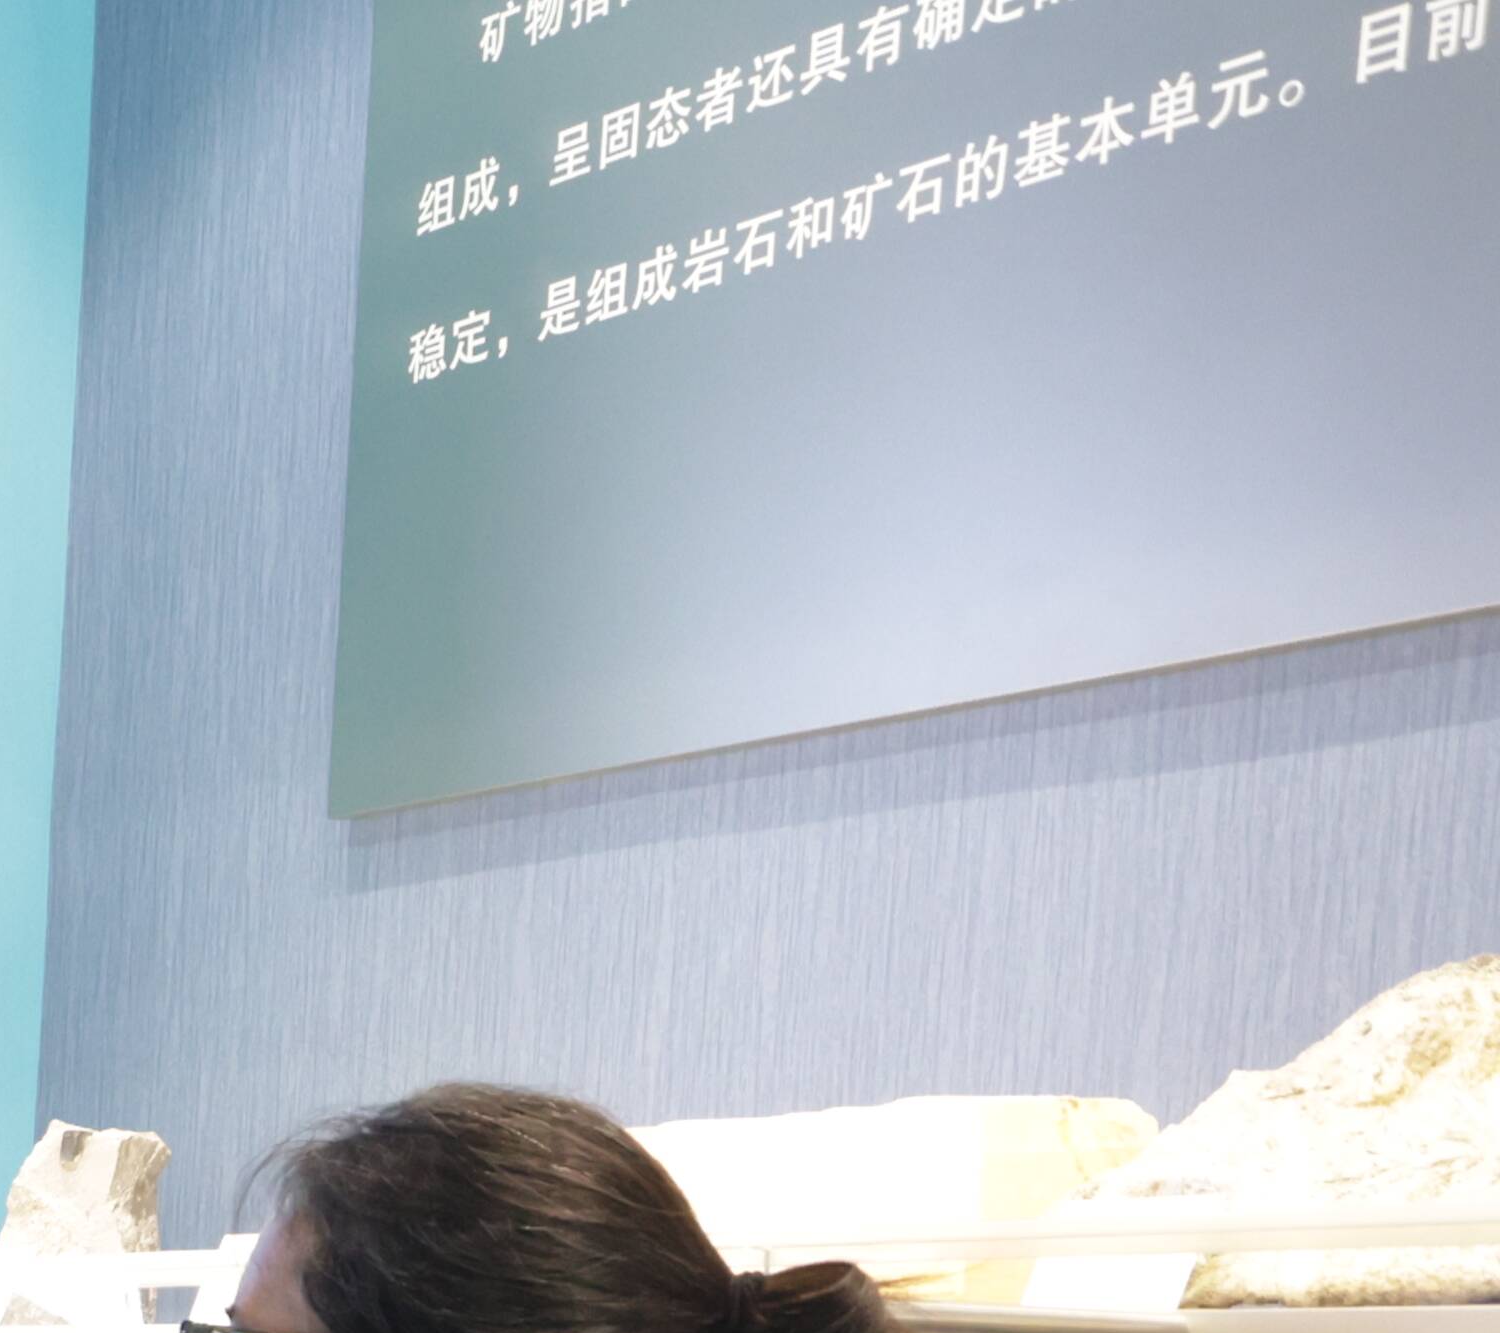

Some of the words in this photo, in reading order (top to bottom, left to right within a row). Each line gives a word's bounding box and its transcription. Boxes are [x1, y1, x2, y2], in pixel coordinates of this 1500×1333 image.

[478, 0, 630, 63] 矿物指
[416, 0, 1076, 236] 组成，呈固态者还具有确
